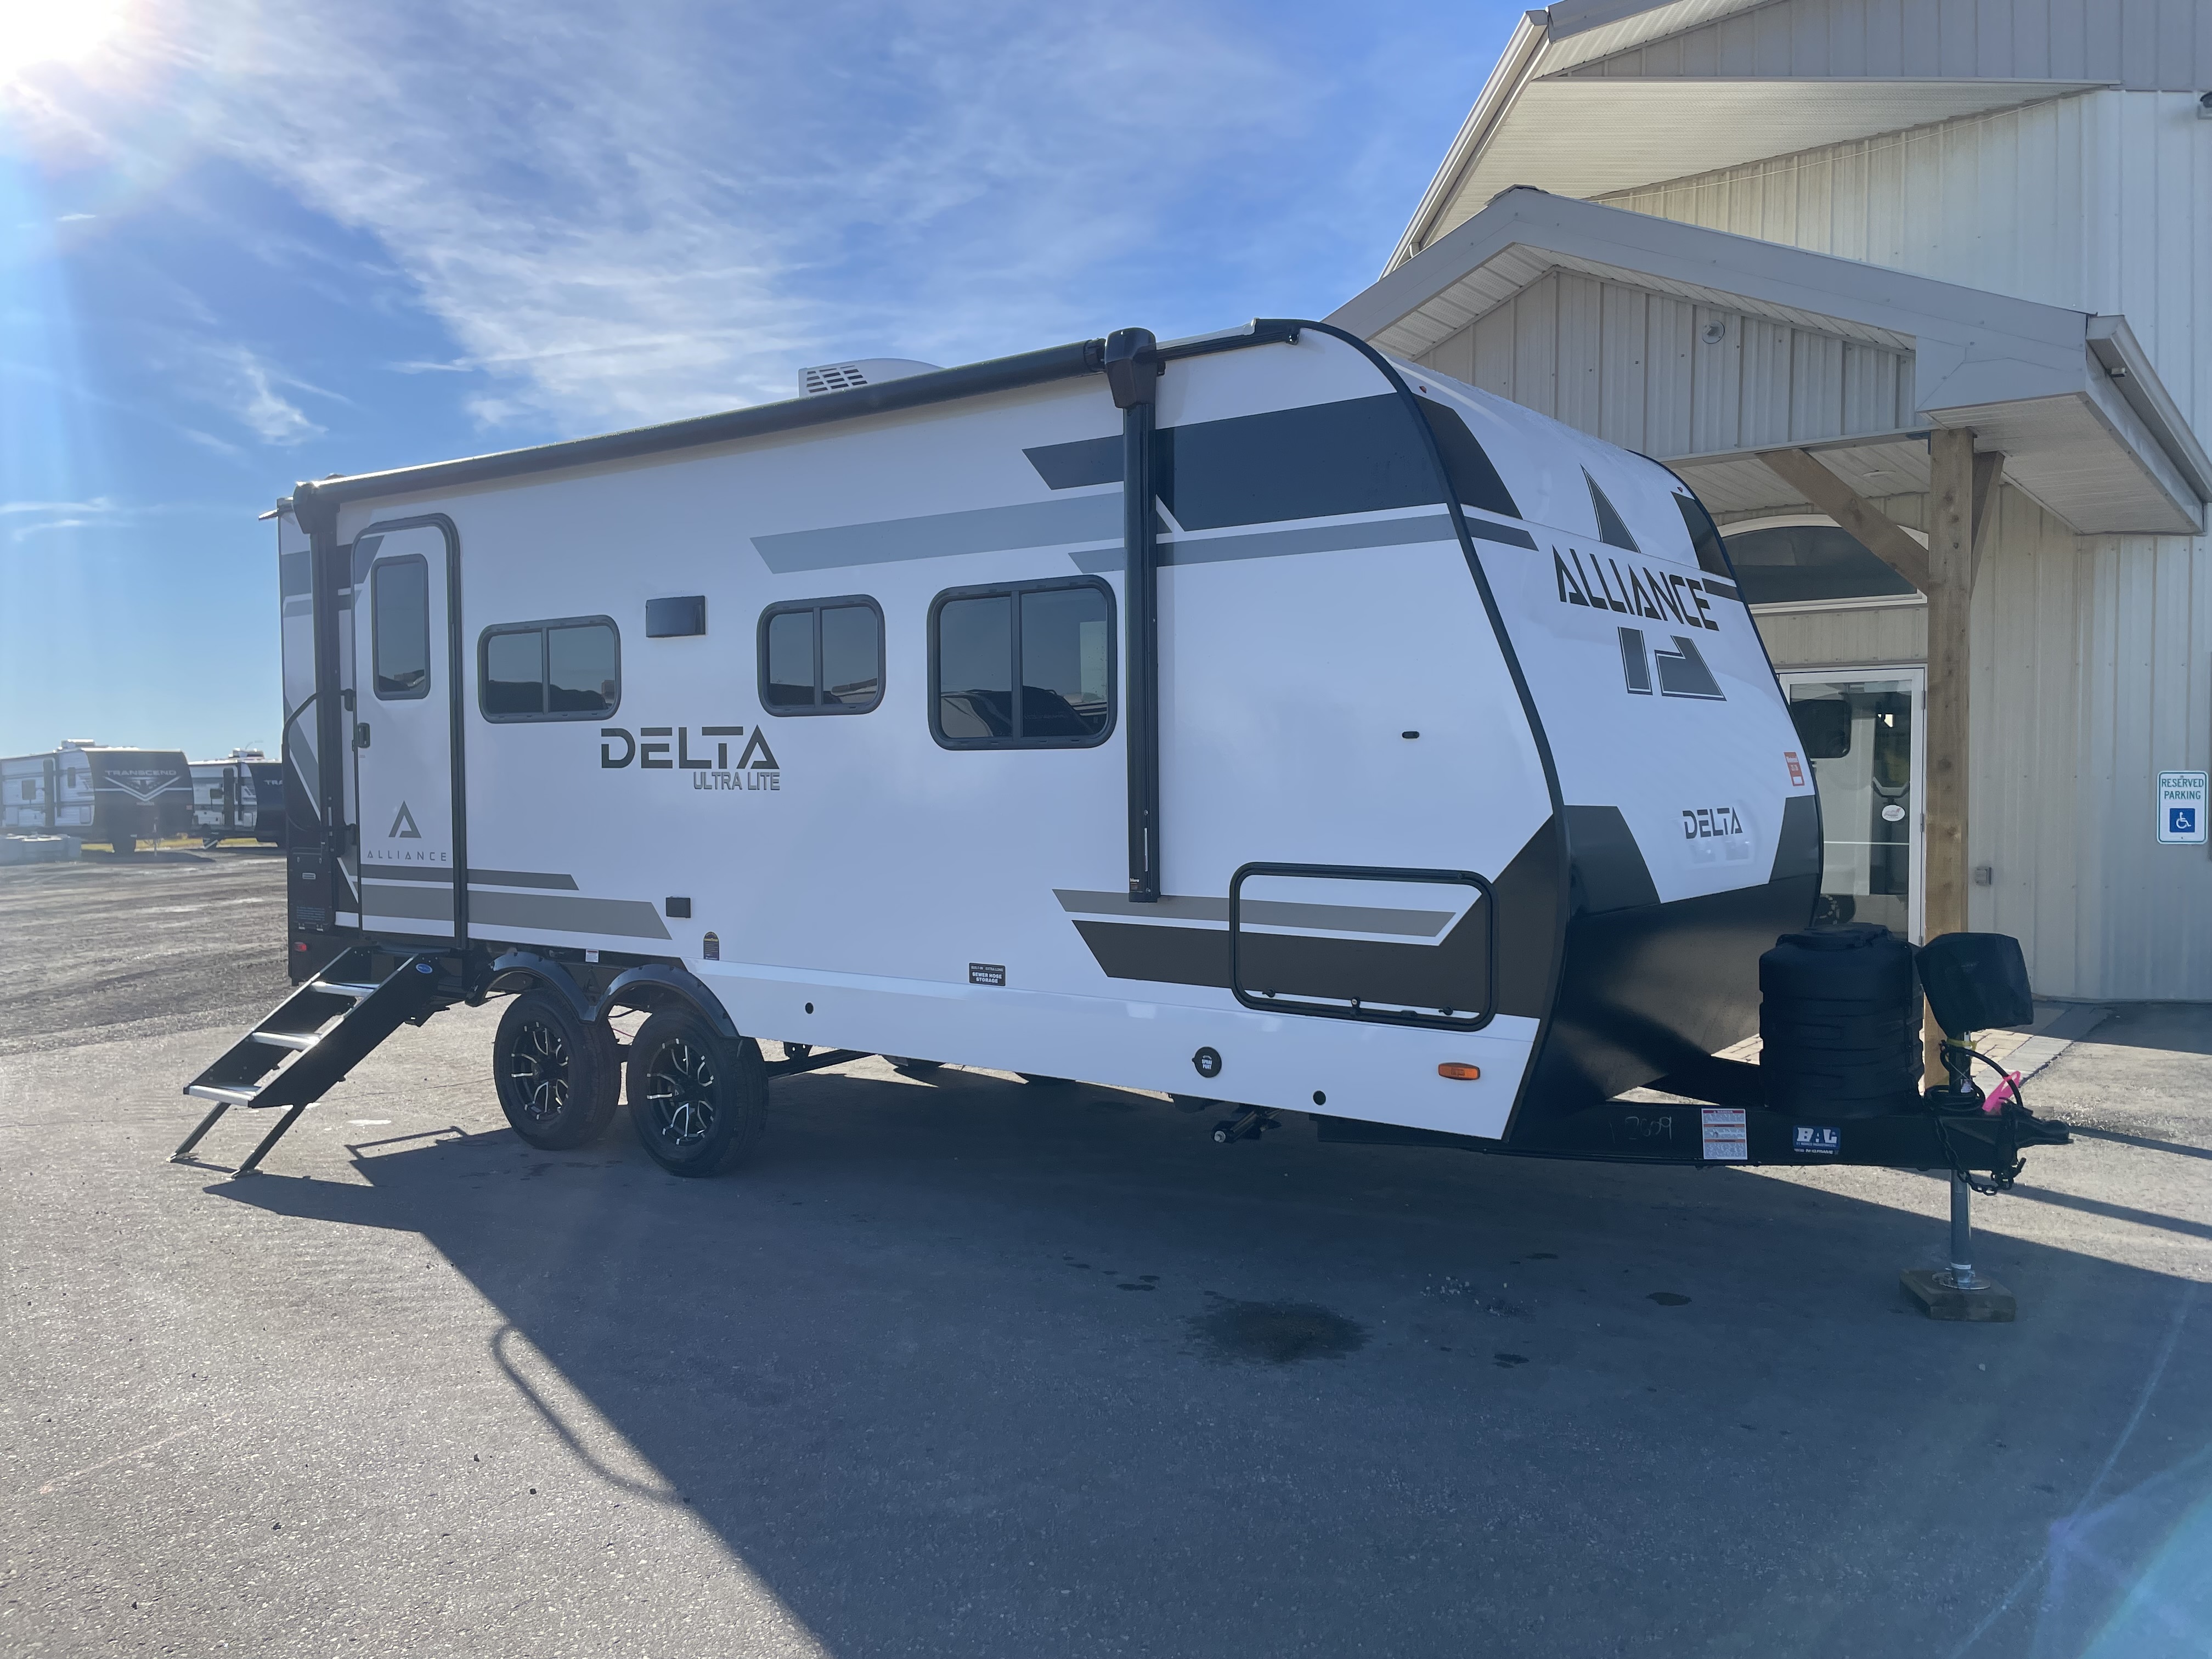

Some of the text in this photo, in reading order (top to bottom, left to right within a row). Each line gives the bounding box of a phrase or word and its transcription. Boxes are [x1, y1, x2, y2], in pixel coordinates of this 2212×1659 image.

[1552, 544, 1719, 631] ALLIANCE
[601, 724, 780, 769] DELTA
[693, 771, 780, 790] ULTRA LITE
[2162, 778, 2204, 787] RESERVED
[2164, 791, 2201, 800] PARKING
[1682, 806, 1743, 839] DELTA
[367, 850, 447, 861] ALLIANCE
